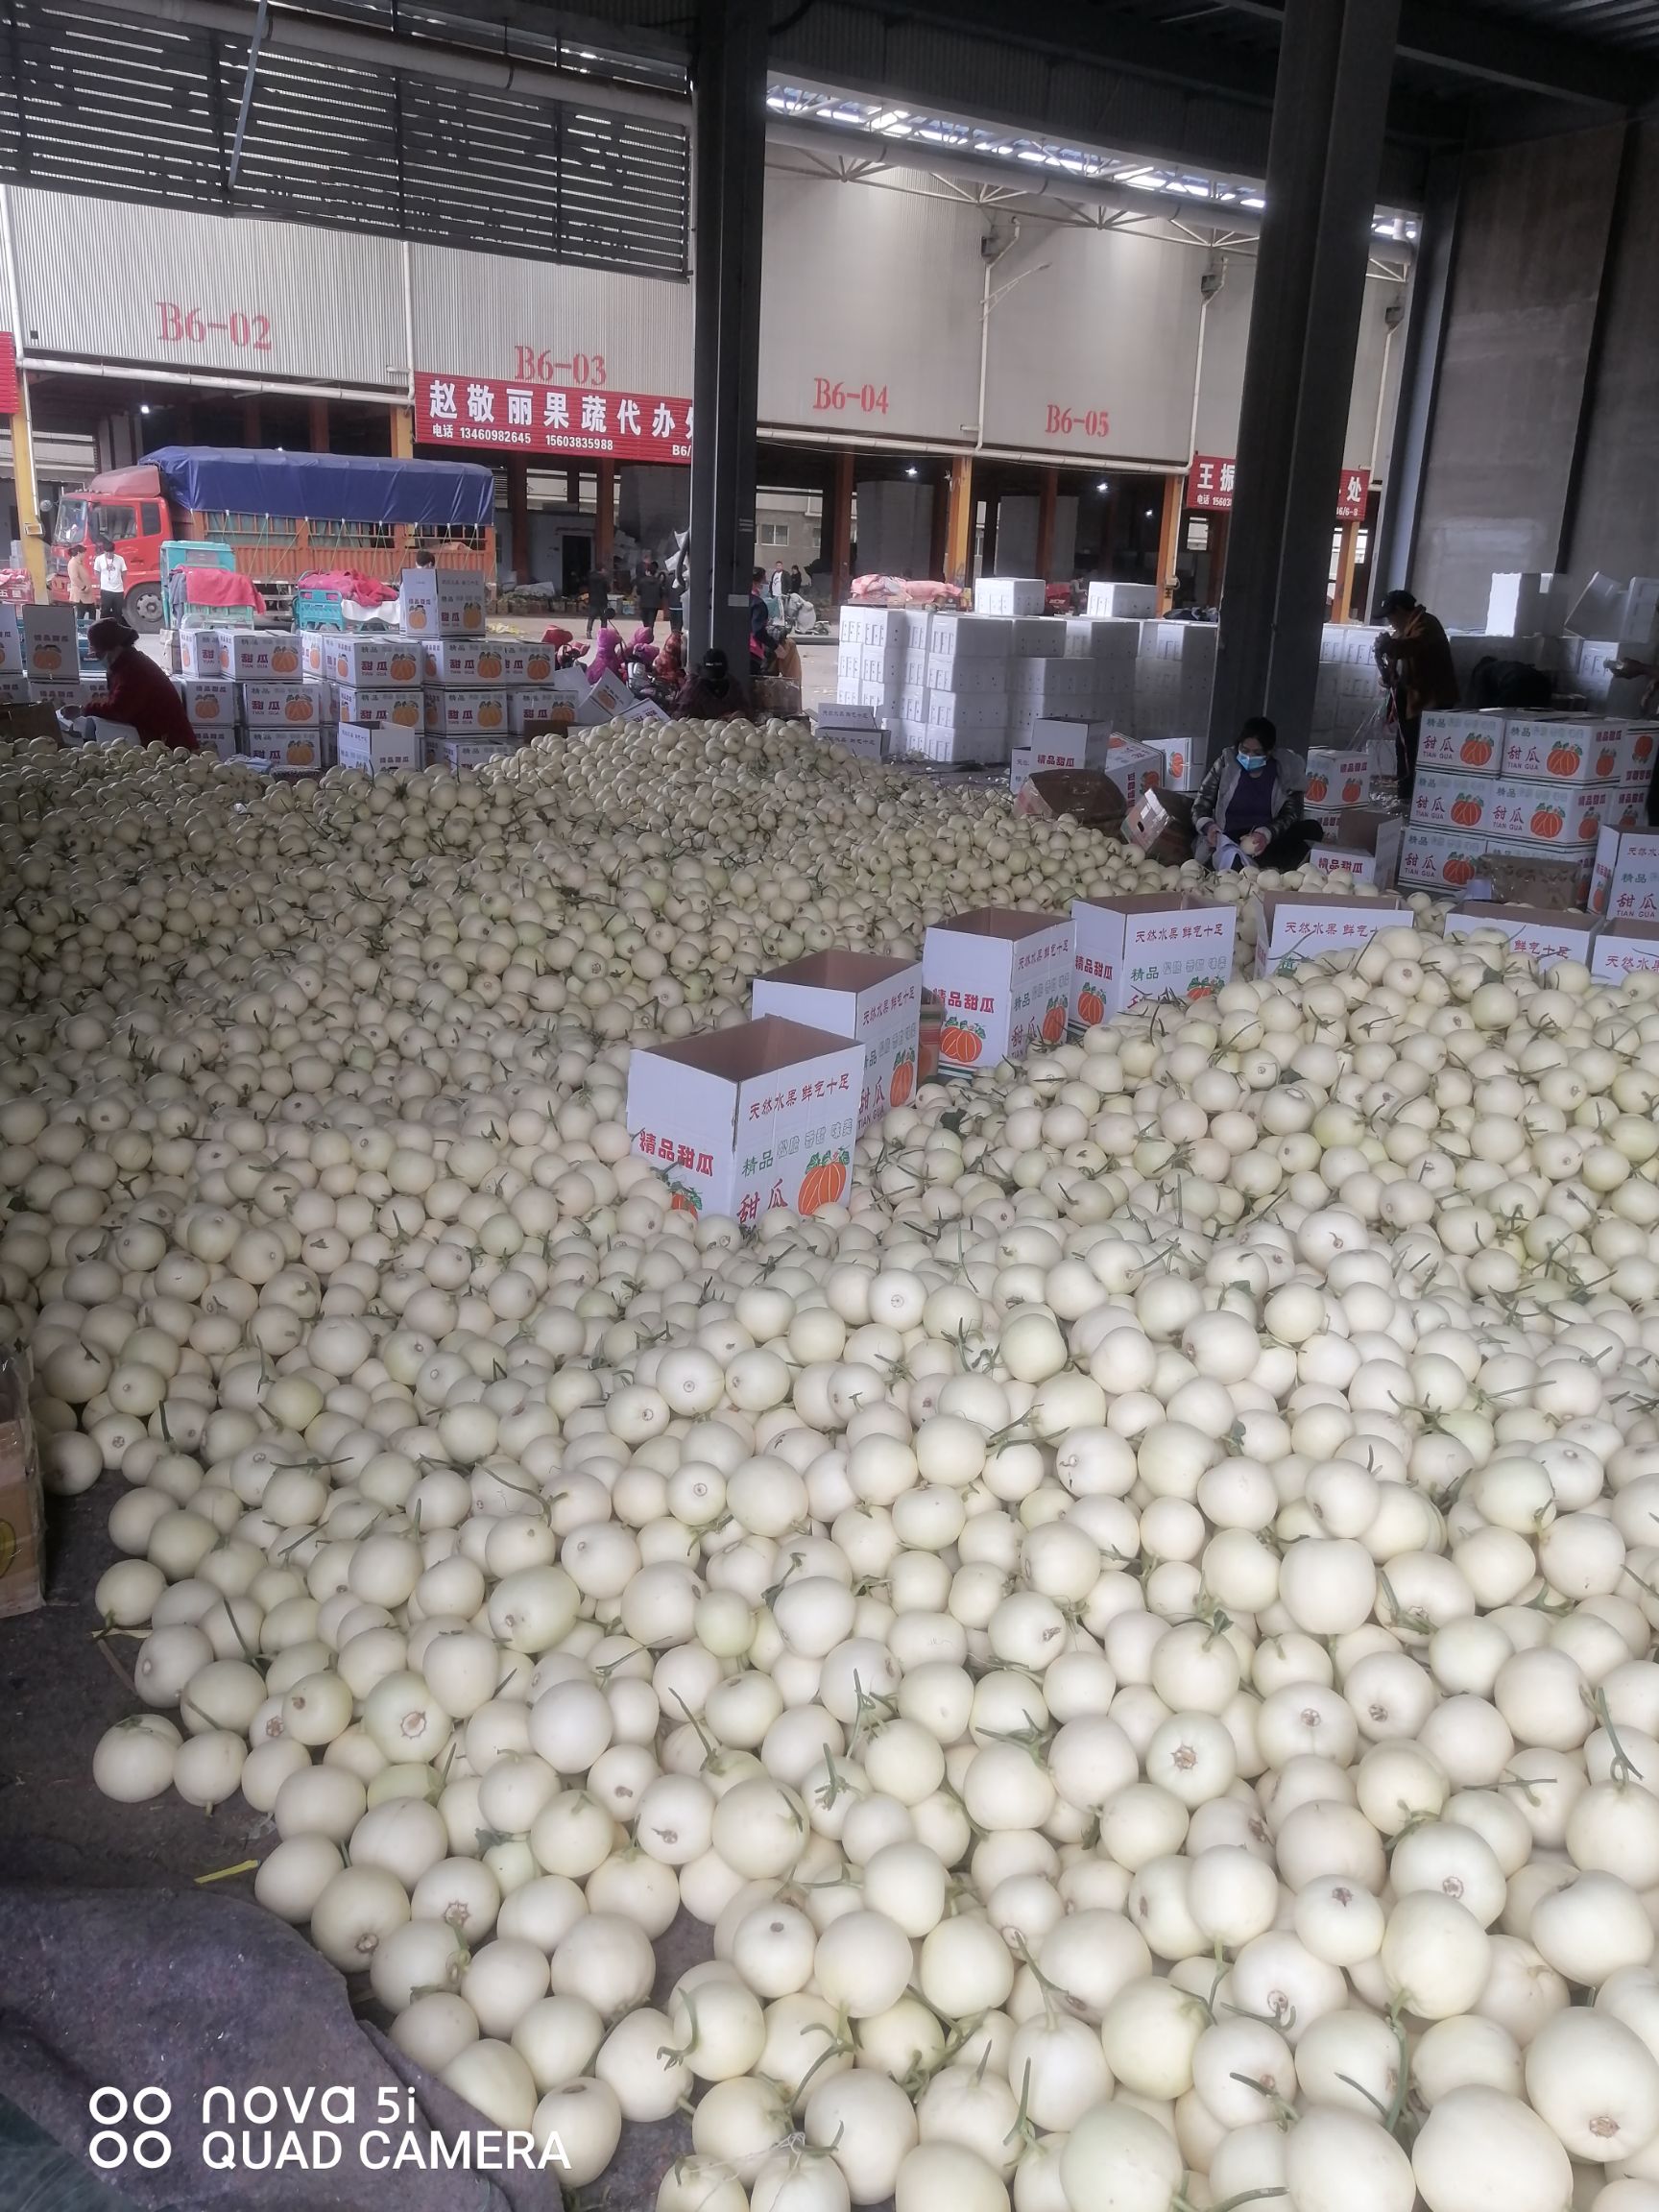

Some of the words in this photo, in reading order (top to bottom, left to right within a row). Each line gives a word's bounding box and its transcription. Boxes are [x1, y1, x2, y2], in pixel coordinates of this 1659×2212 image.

[155, 301, 273, 351] B6-02
[514, 345, 607, 386] B6-03
[812, 376, 889, 415] B6-04
[1045, 403, 1110, 438] B6-05
[432, 423, 454, 439] 电话
[459, 427, 531, 444] 13460982645
[545, 435, 613, 451] 15603835988
[672, 445, 692, 457] B6/
[1197, 463, 1237, 493] 王振
[361, 661, 388, 671] 甜瓜
[1423, 734, 1455, 753] 甜瓜
[1037, 754, 1075, 768] 精品甜瓜
[1507, 745, 1540, 763] 甜瓜
[1416, 795, 1445, 812] 甜瓜
[1492, 805, 1525, 824] 甜瓜
[1509, 823, 1523, 831] GUA
[1405, 853, 1436, 871] 甜瓜
[1405, 867, 1419, 876] TIAN
[1421, 869, 1435, 878] GUA
[1616, 893, 1658, 910] 甜瓜
[1135, 926, 1179, 944] 天然水果
[1285, 921, 1337, 936] 天然水果
[1074, 954, 1114, 981] 精品甜瓜
[1130, 966, 1160, 982] 精品
[749, 1090, 797, 1121] 天然水果
[639, 1129, 714, 1177] 精品甜瓜
[741, 1149, 774, 1179] 精品
[736, 1178, 788, 1223] 甜瓜
